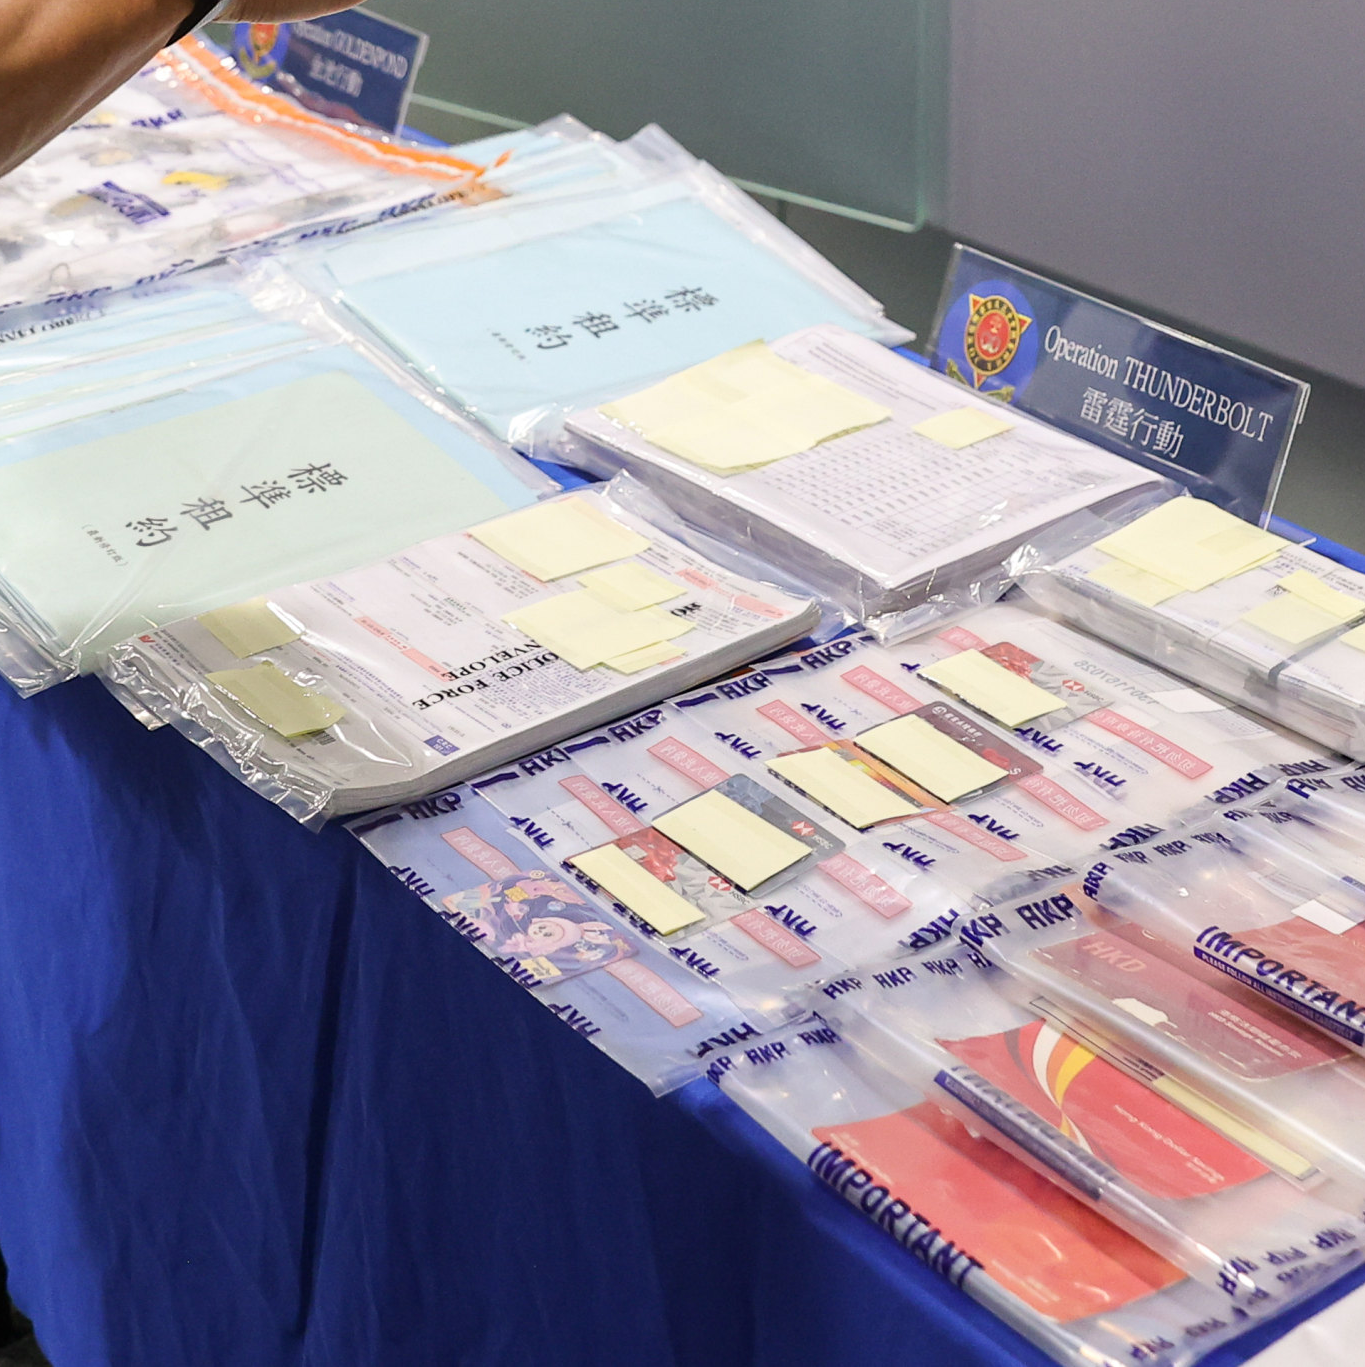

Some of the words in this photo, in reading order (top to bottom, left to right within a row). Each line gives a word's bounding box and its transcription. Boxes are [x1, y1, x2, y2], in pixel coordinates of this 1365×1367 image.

[1044, 325, 1119, 381] Operation
[1124, 355, 1274, 443] THUNDERBOLT
[1079, 386, 1185, 460] 雷霆行動
[125, 462, 348, 548] 標準租約
[441, 638, 544, 681] NVELOPE
[492, 651, 560, 683] OLICE
[801, 640, 853, 669] HKP
[412, 677, 493, 711] FORCE
[1084, 941, 1146, 973] HKD
[1202, 953, 1226, 972] PLEASE
[807, 1142, 984, 1287] IMPORTANT
